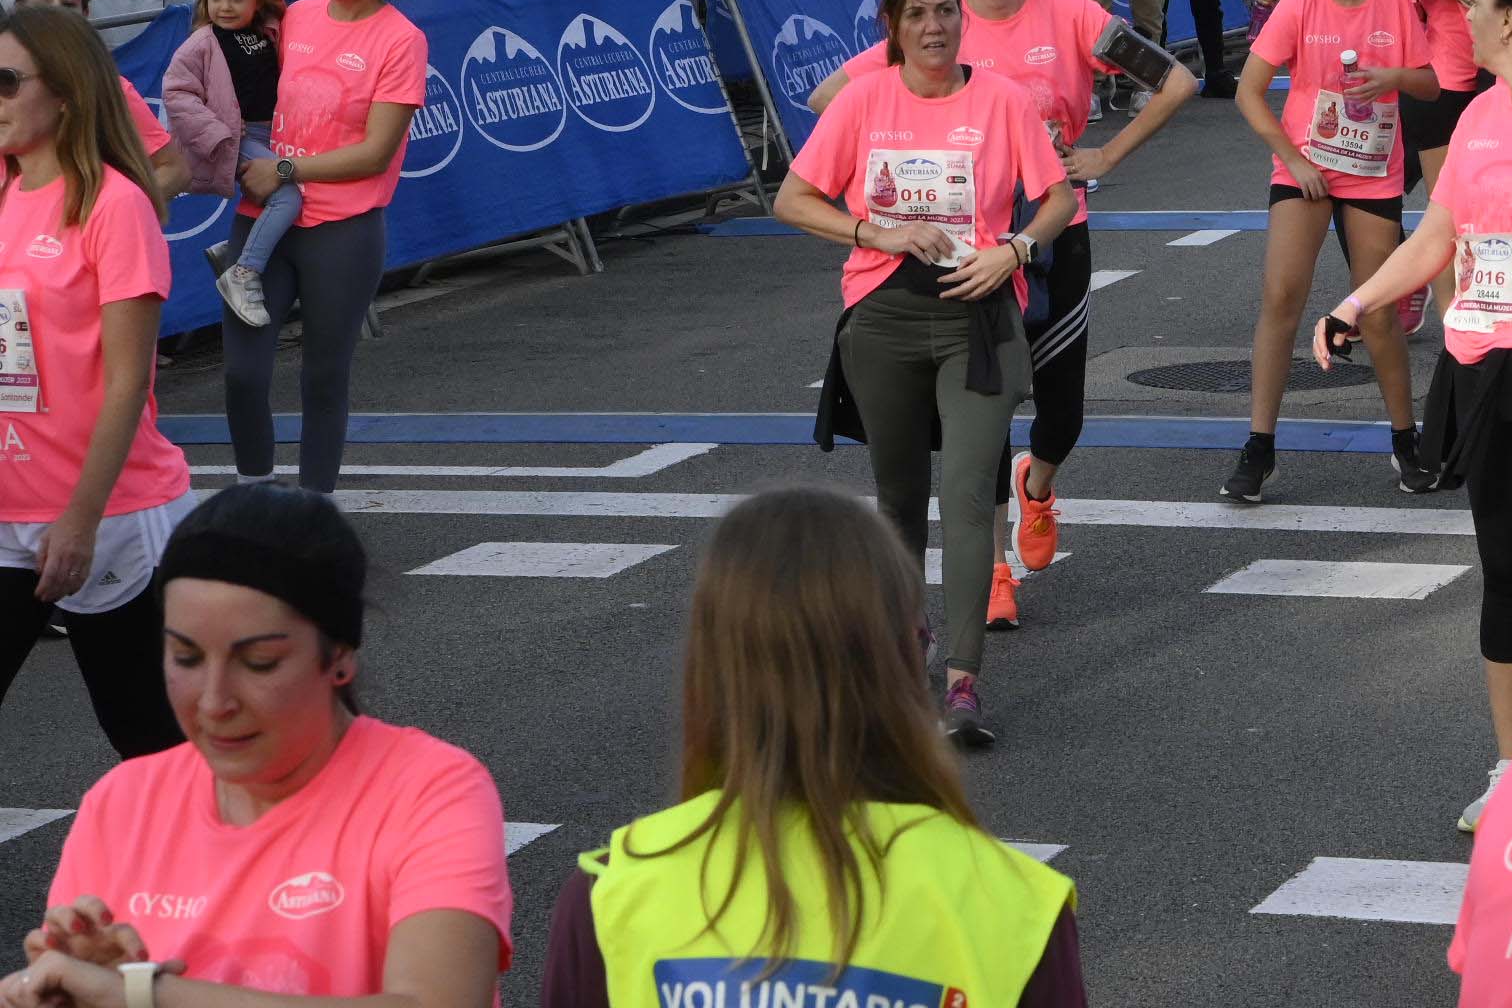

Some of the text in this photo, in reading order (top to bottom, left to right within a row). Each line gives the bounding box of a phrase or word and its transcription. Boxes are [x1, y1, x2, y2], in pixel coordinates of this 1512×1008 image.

[1305, 35, 1341, 45] OYSHO
[659, 46, 720, 91] ASTUR
[566, 62, 651, 107] ASTURIANA
[471, 75, 563, 126] ASTURIANA
[406, 100, 458, 143] RIANA
[869, 130, 913, 142] OYSHO
[1340, 126, 1369, 141] 016
[1340, 140, 1364, 150] 13594
[899, 165, 939, 175] ASTURIANA
[900, 188, 937, 202] 016
[907, 205, 931, 213] 3253
[1475, 271, 1506, 286] 016
[1476, 288, 1501, 300] 28444
